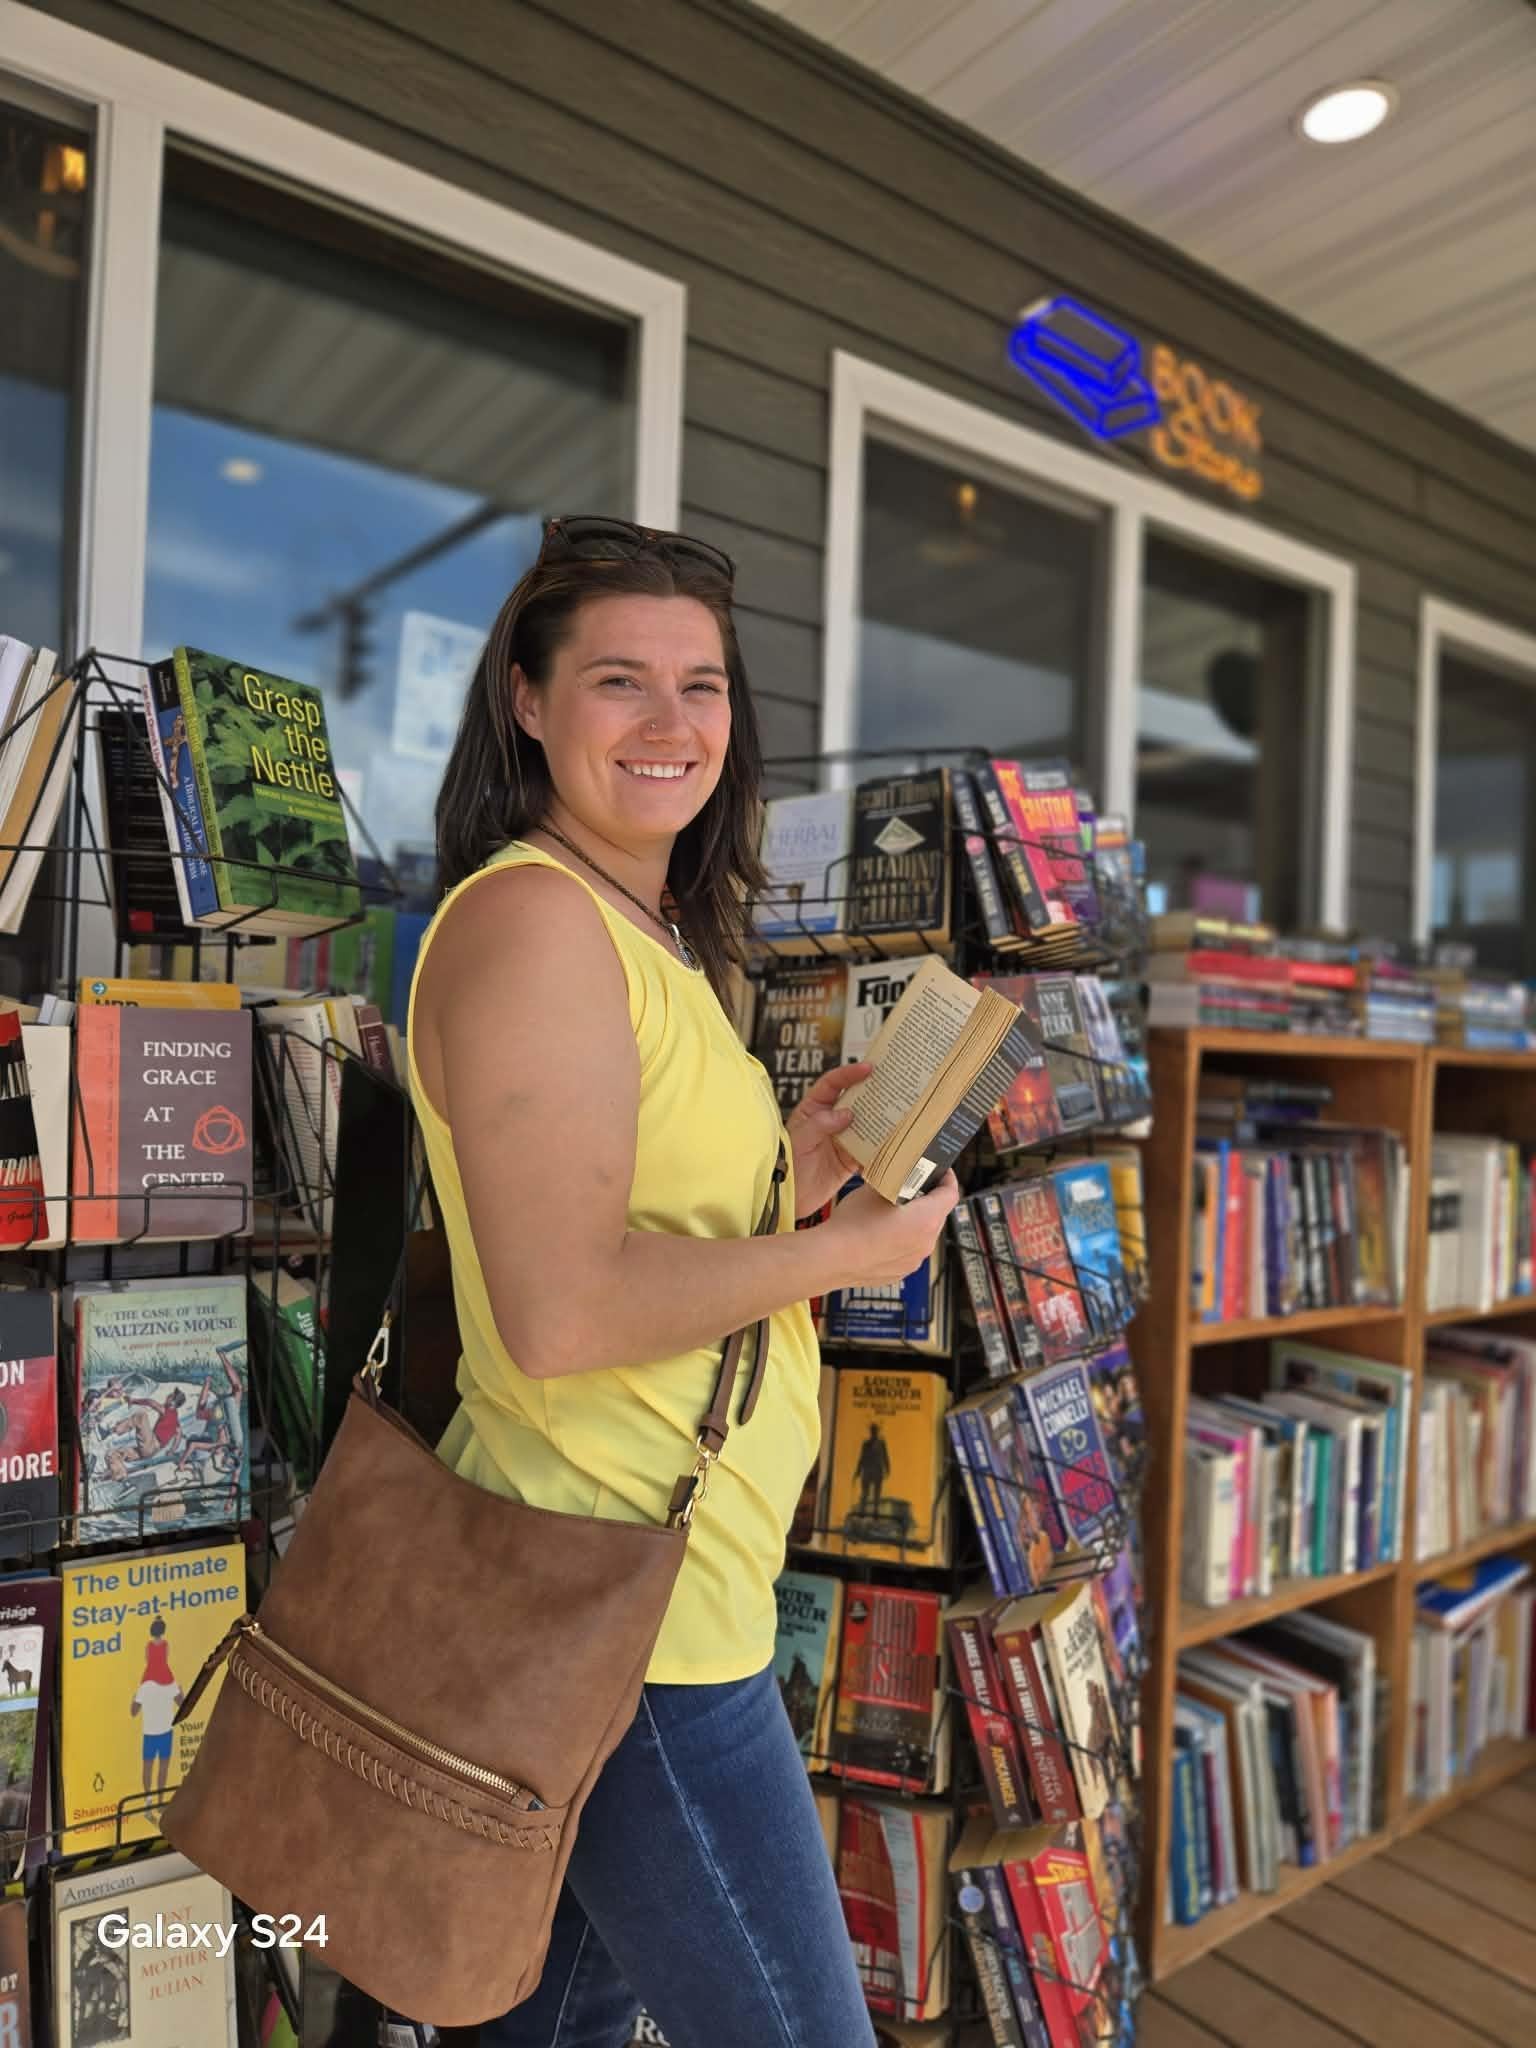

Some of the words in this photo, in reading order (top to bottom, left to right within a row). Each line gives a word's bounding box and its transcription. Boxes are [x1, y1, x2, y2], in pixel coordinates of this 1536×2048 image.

[243, 673, 321, 733] Grasp
[283, 724, 328, 763] the
[251, 745, 335, 798] Nettle
[780, 1022, 821, 1047] ONE
[143, 1041, 232, 1058] FINDING
[775, 1048, 825, 1073] YEAR
[143, 1069, 217, 1086] GRACE
[143, 1106, 174, 1123] AT
[142, 1144, 185, 1160] THE
[114, 1308, 138, 1321] THE
[142, 1306, 176, 1320] CASE
[179, 1305, 194, 1318] OF
[197, 1303, 218, 1316] THE
[95, 1318, 182, 1339] WALTZING
[183, 1315, 238, 1333] MOUSE
[1035, 1375, 1086, 1418] MICHAEL
[72, 1575, 120, 1597] The
[128, 1555, 229, 1587] Ultimate
[72, 1583, 240, 1629] Stay-at-Home
[72, 1635, 122, 1660] Dad
[961, 1631, 982, 1669] JAMES
[65, 1874, 136, 1903] American
[141, 1949, 208, 1979] MOTHER
[148, 1973, 206, 2001] JULIAN
